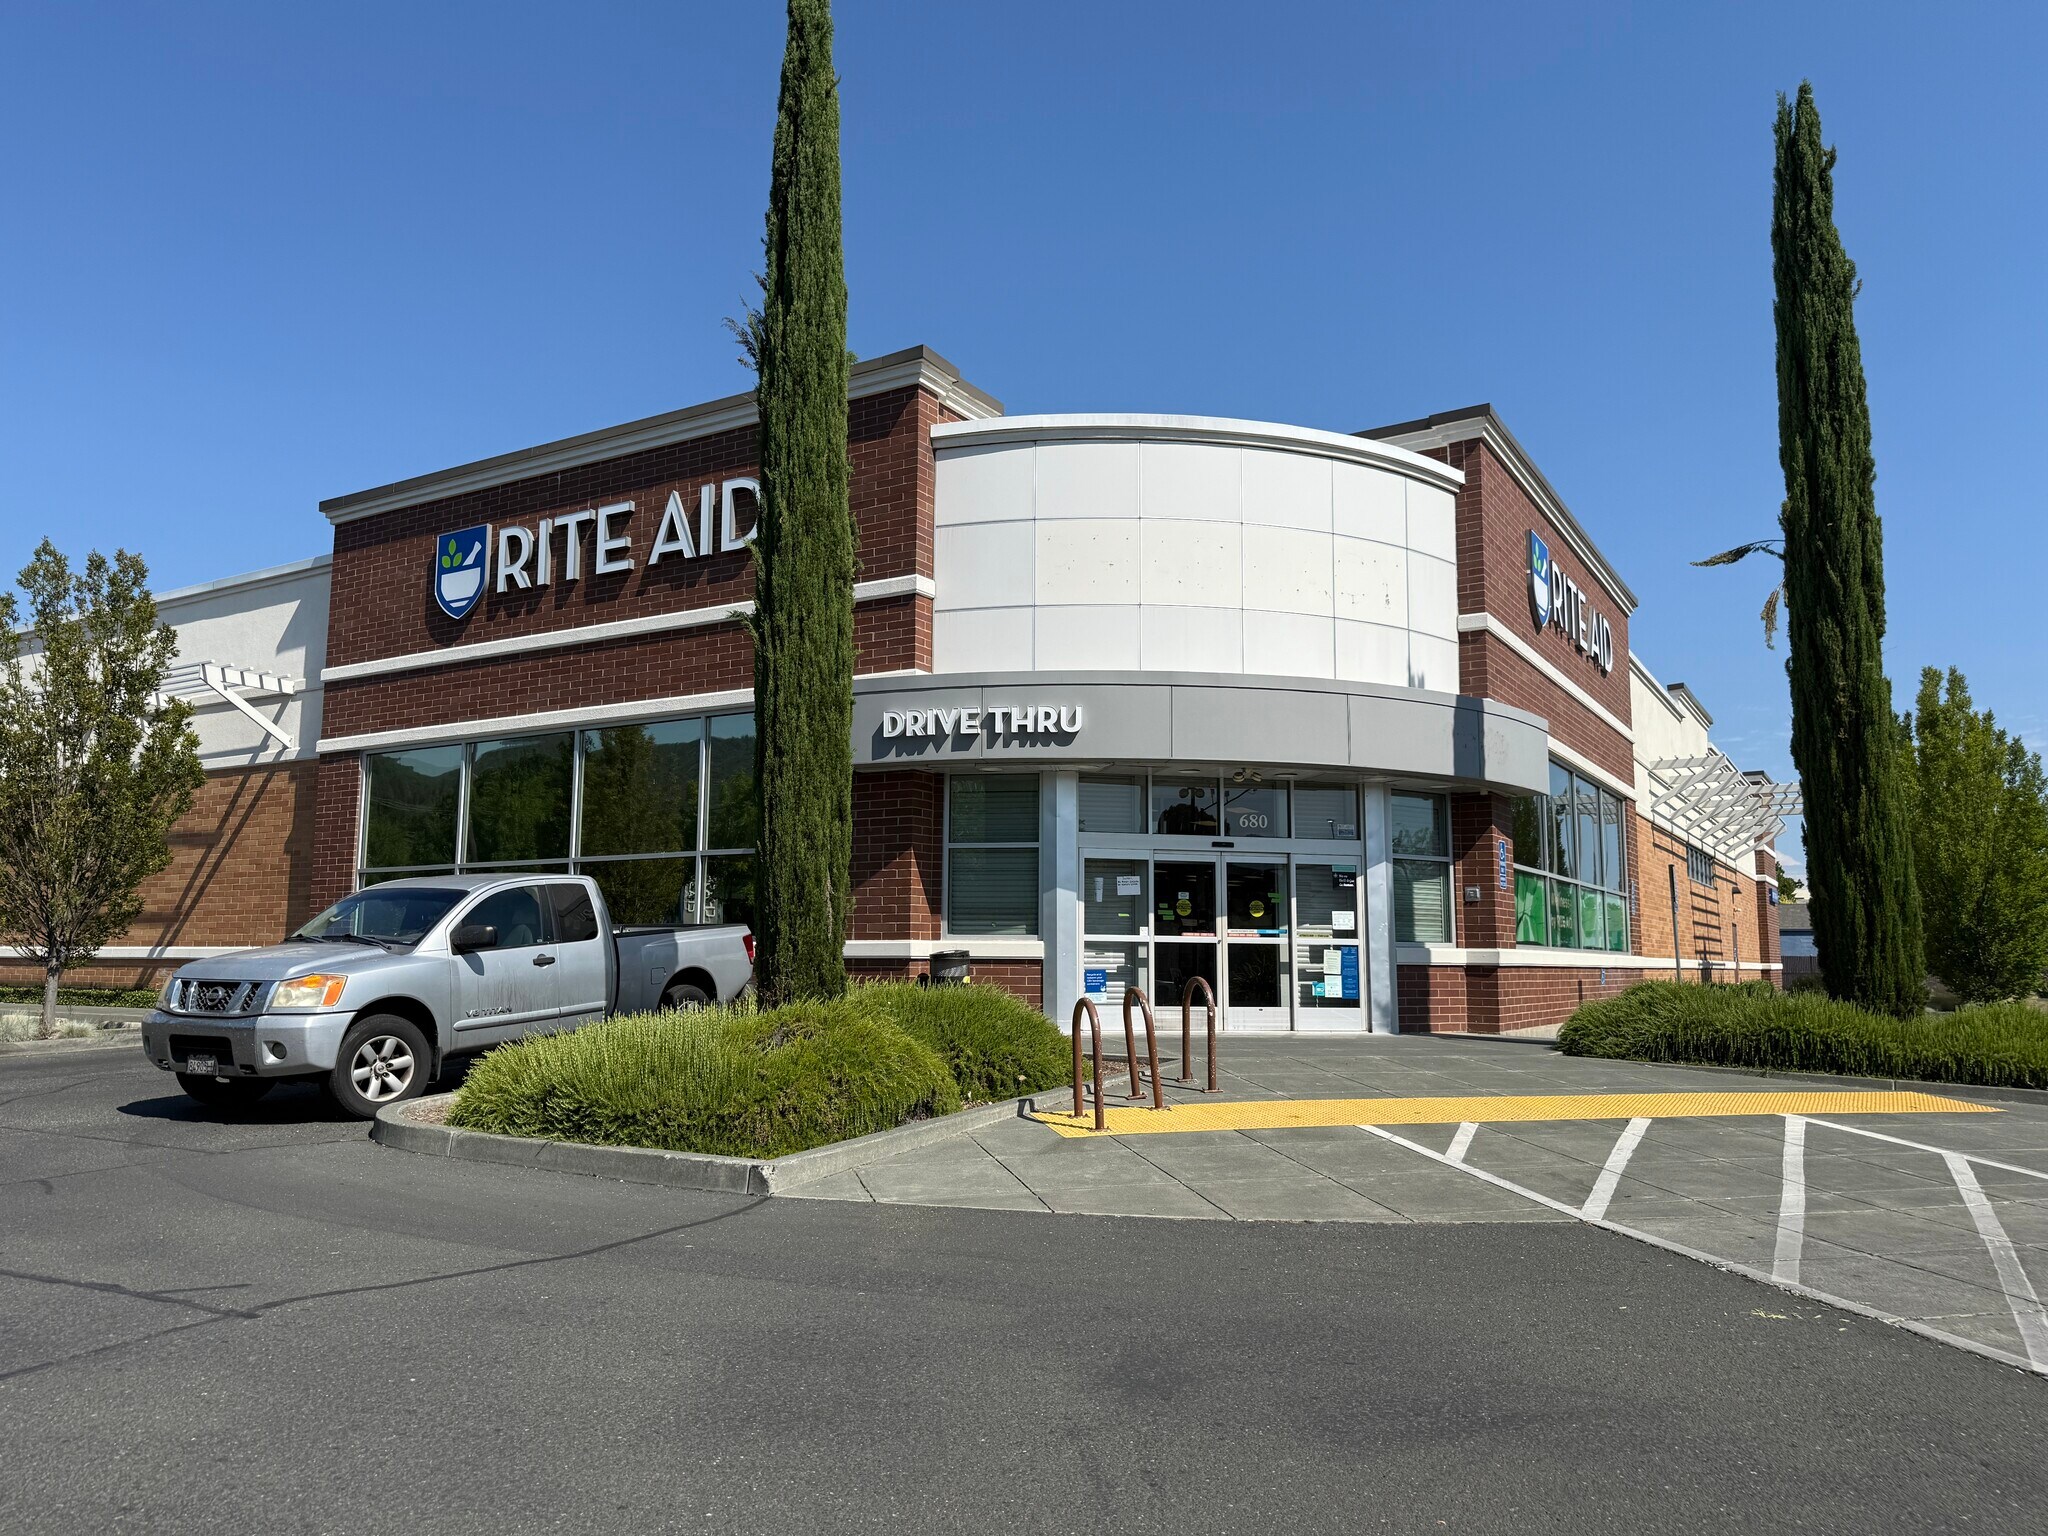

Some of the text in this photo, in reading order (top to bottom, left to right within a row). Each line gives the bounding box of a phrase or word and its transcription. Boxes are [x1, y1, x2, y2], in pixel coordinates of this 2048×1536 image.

[496, 476, 760, 593] RITE AID
[1550, 560, 1613, 672] RITE AID
[883, 704, 1083, 738] DRIVE THRU
[1239, 814, 1268, 829] 680
[482, 1006, 512, 1016] TITAN
